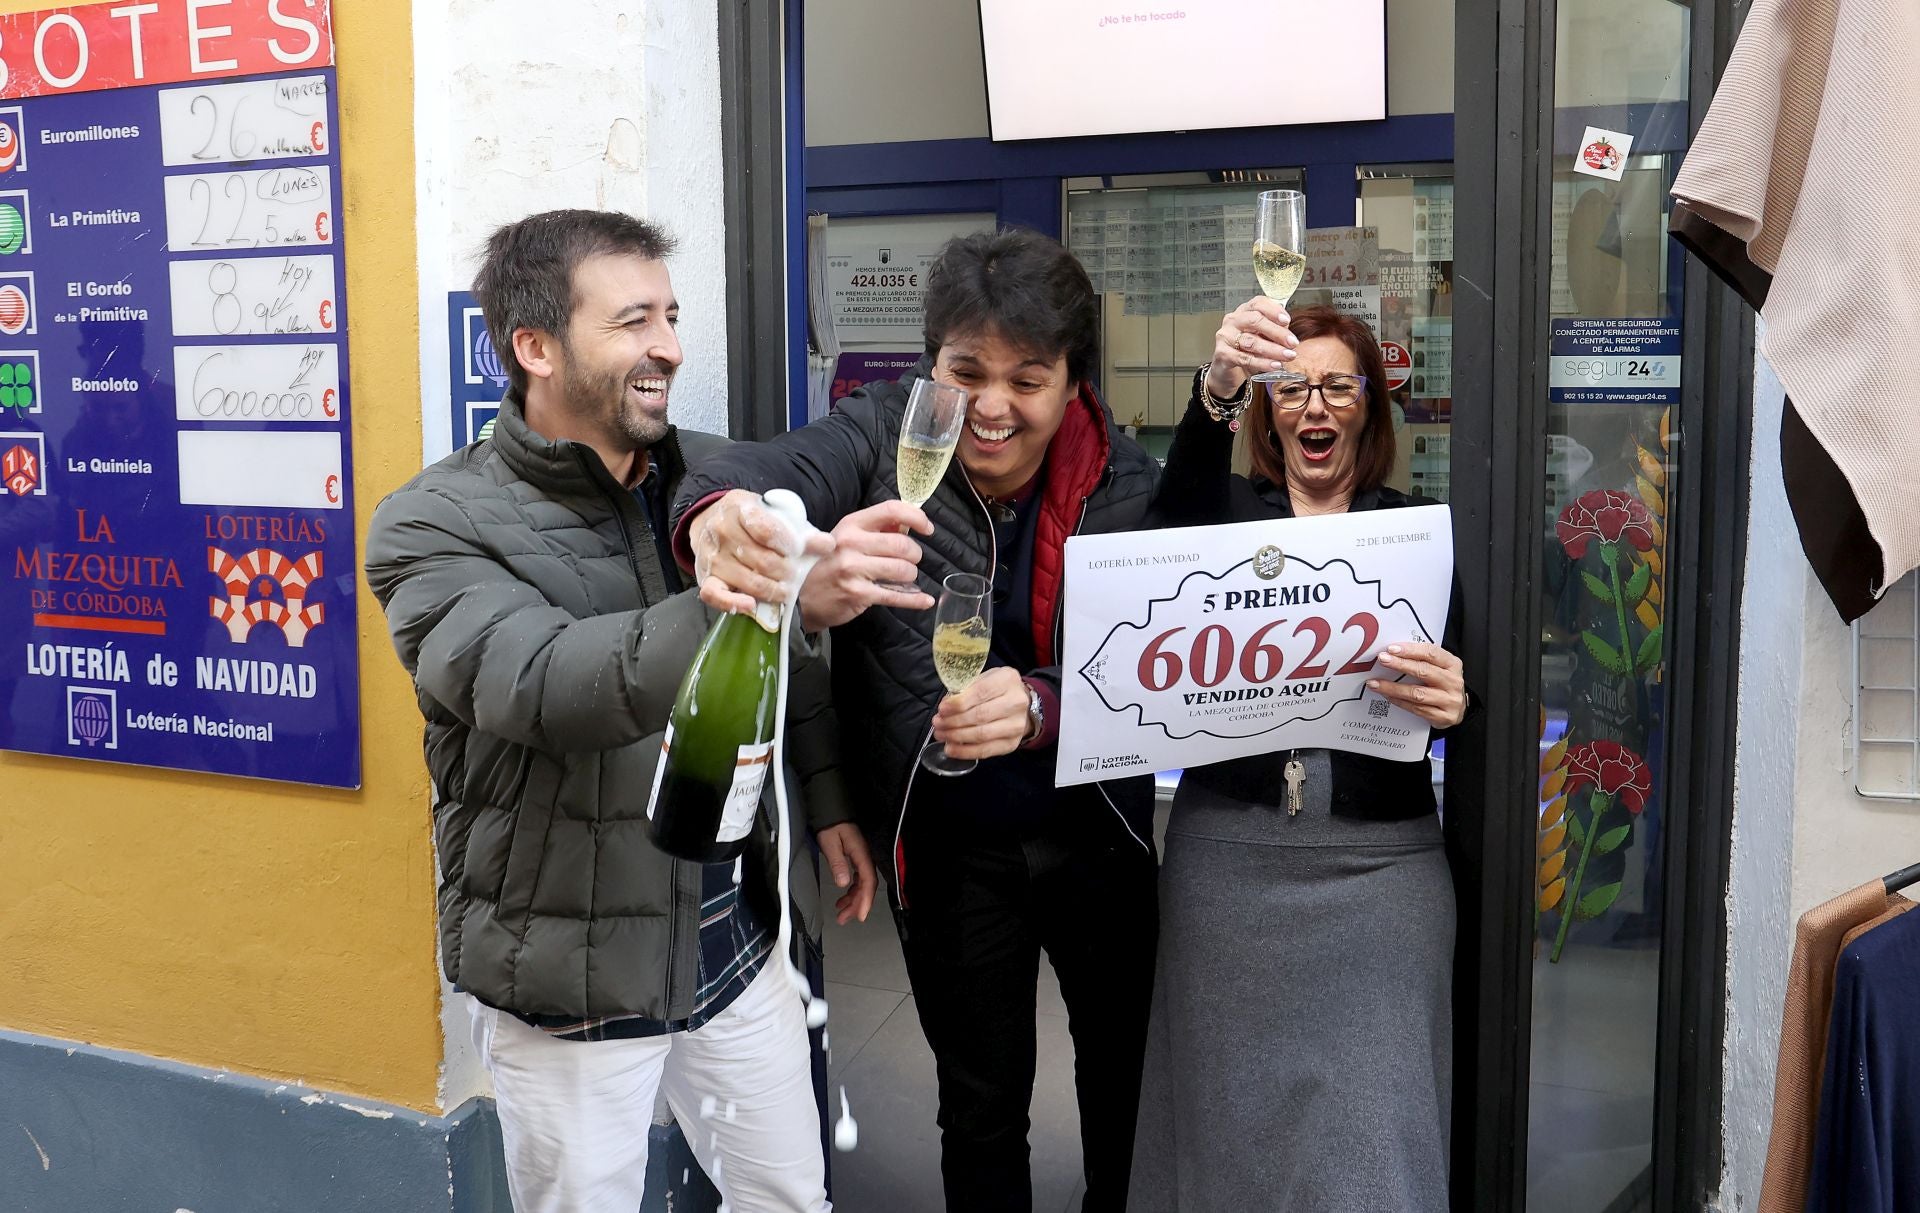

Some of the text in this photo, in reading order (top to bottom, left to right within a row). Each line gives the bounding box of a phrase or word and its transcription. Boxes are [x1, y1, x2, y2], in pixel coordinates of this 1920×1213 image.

[1099, 10, 1186, 27] ¿No te ha tocado
[0, 0, 320, 90] OTES
[41, 125, 140, 145] Euromillones
[190, 95, 257, 160] 26
[50, 210, 141, 228] La Primitiva
[67, 281, 132, 297] El Gordo
[851, 274, 918, 287] 424.035 €
[1333, 289, 1363, 299] Juega el
[1348, 301, 1358, 309] de
[1359, 301, 1367, 309] la
[54, 307, 148, 323] de la Primitiva
[1572, 320, 1604, 328] SISTEMA
[1603, 328, 1679, 336] PERMANENTEMENTE
[864, 360, 919, 368] EURO DREAM
[71, 378, 139, 393] Bonoloto
[1606, 393, 1667, 401] www.segur24.es
[68, 458, 153, 475] La Quiniela
[76, 509, 116, 544] LA
[205, 512, 326, 543] LOTERÍAS
[1355, 532, 1432, 547] 22 DE DICIEMBRE
[14, 546, 185, 592] MEZQUITA
[1088, 553, 1200, 570] LOTERÍA DE NAVIDAD
[31, 588, 168, 618] DE CÓRDOBA
[1224, 583, 1331, 611] PREMIO
[1137, 611, 1379, 692] 60622
[26, 641, 317, 699] LOTERÍA de NAVIDAD
[1182, 677, 1331, 706] VENDIDO AQUÍ
[1204, 704, 1254, 716] MEZQUITA
[1256, 703, 1270, 711] DE
[1271, 697, 1316, 708] CORDOBA
[126, 708, 274, 742] Lotería Nacional
[1228, 711, 1274, 722] CORDOBA
[1342, 721, 1411, 737] COMPARTIRLO
[1340, 733, 1406, 750] EXTRAORDINARIO
[1101, 758, 1149, 770] NACIONAL
[1102, 753, 1140, 764] LOTERÍA
